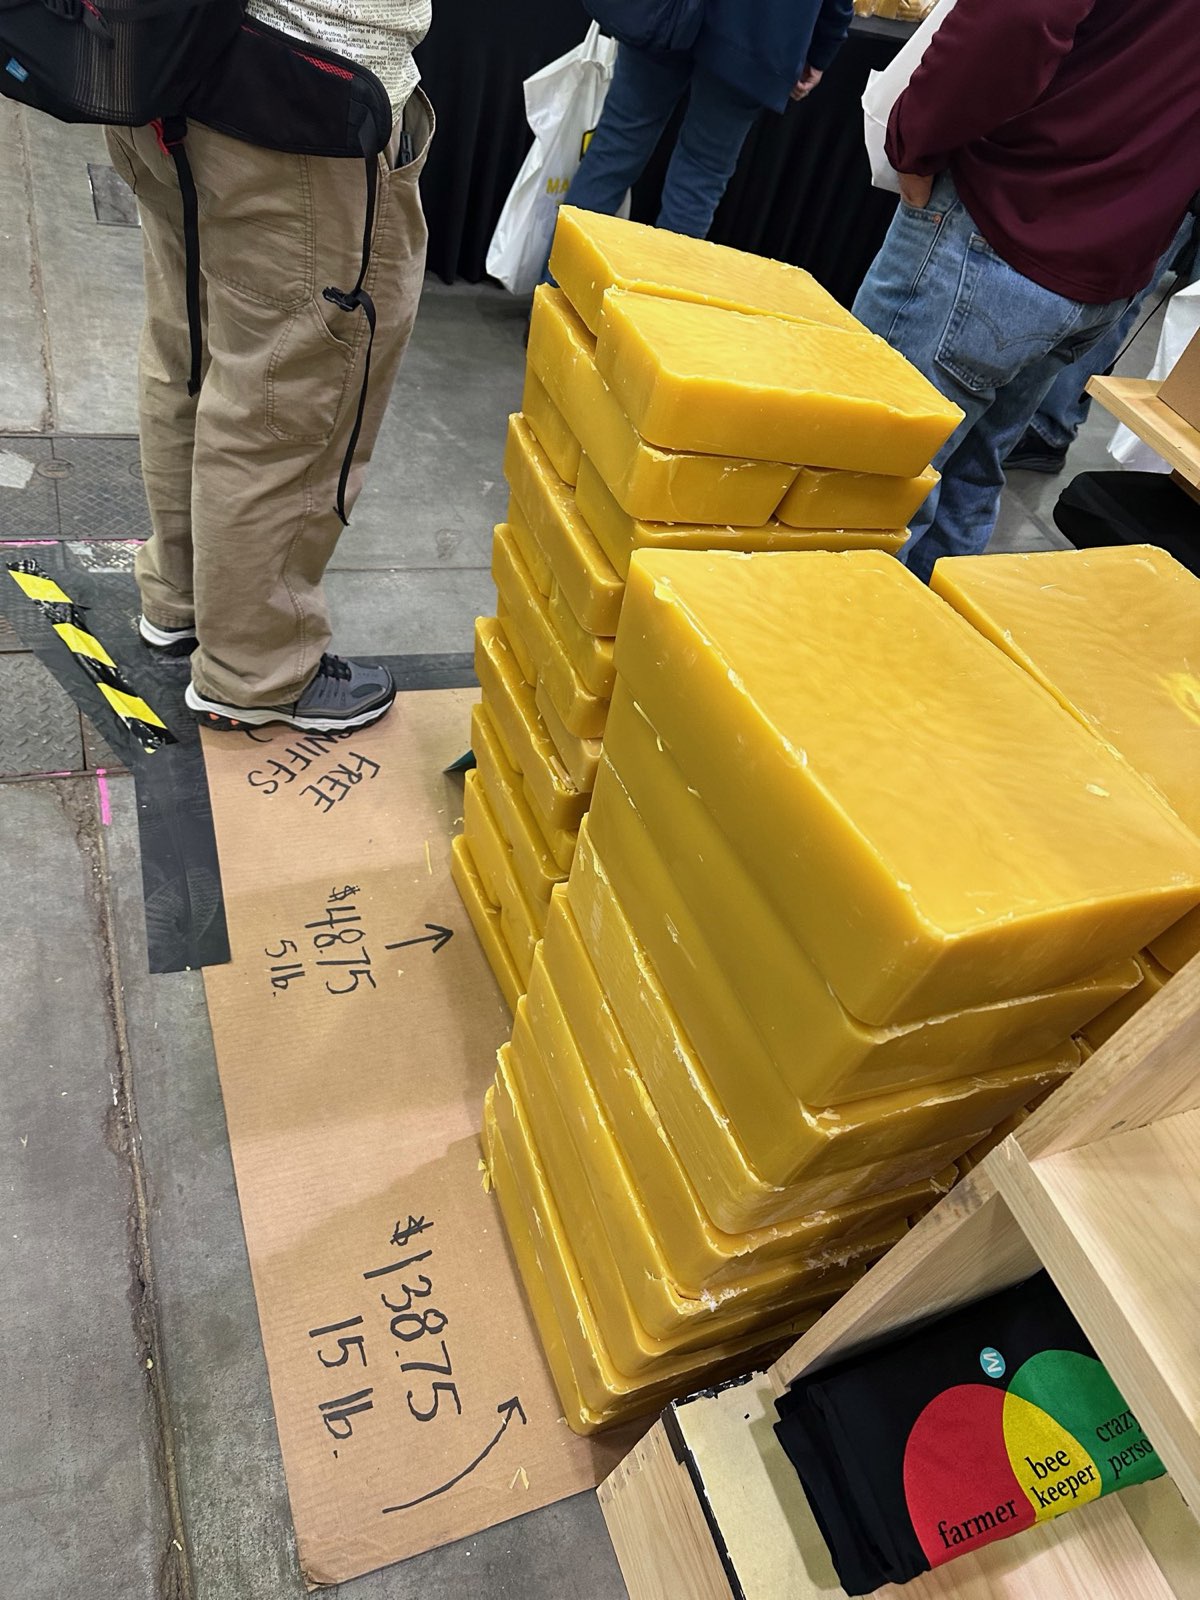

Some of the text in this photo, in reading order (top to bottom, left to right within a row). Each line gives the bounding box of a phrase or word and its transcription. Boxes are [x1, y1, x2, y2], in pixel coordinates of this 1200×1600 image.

[546, 177, 570, 194] MA
[247, 731, 353, 795] NIFFS
[298, 751, 381, 813] FREE
[305, 885, 377, 995] $48.75
[363, 1215, 462, 1422] $138.75
[309, 1315, 374, 1458] 15 lb.
[983, 1351, 1003, 1374] M
[1025, 1449, 1071, 1480] bee
[1108, 1438, 1154, 1480] perso
[1030, 1464, 1096, 1508] keeper
[937, 1499, 1019, 1549] farmer
